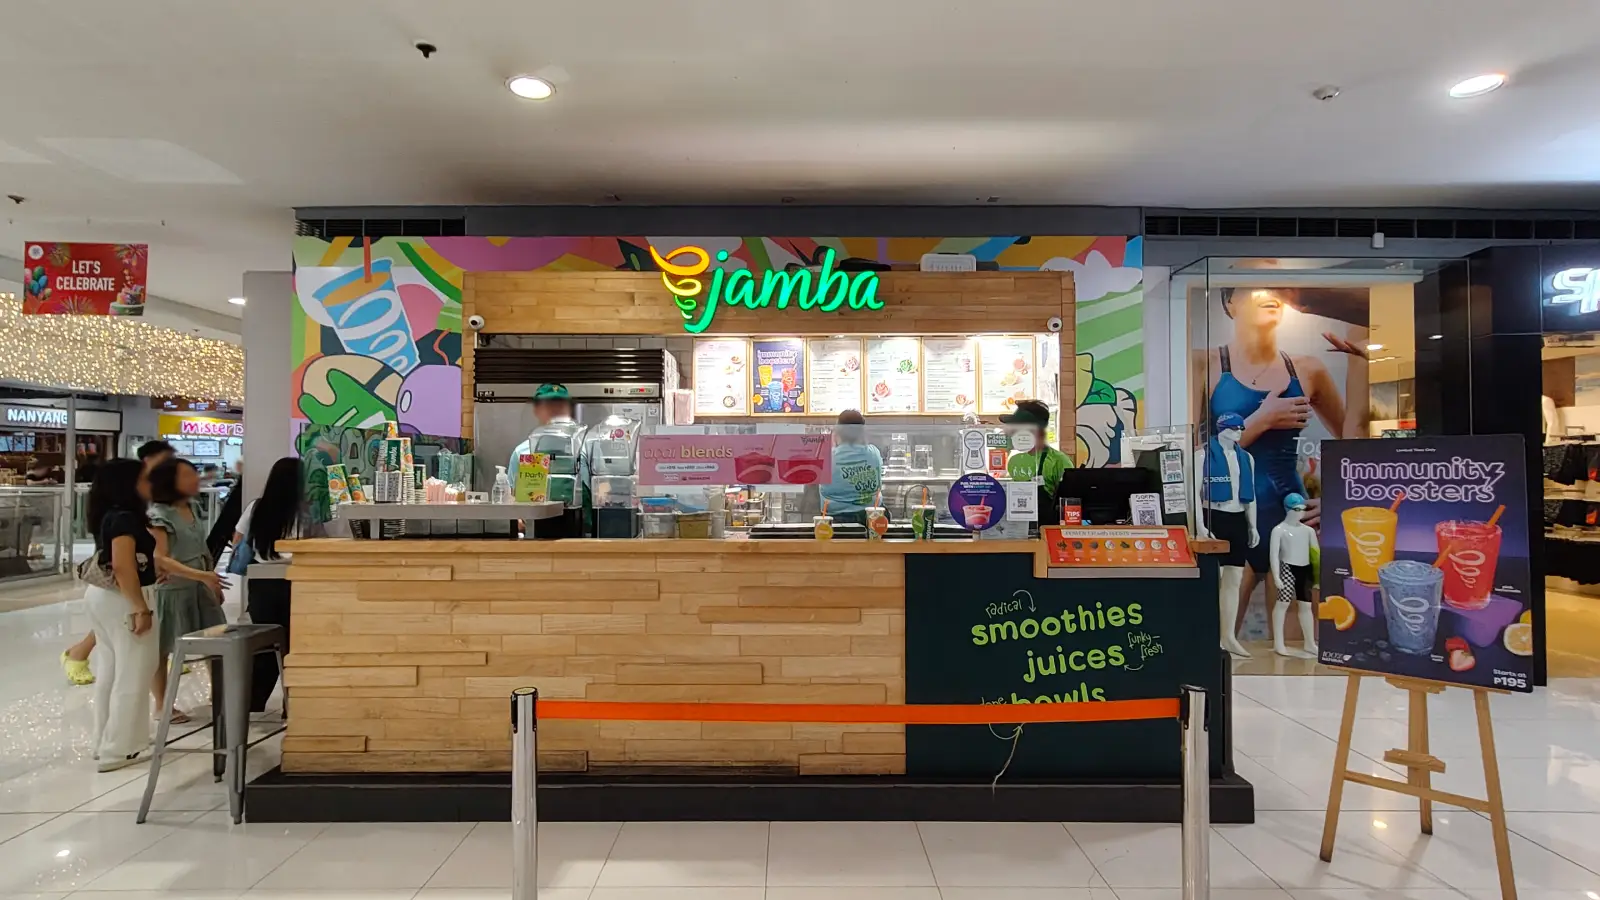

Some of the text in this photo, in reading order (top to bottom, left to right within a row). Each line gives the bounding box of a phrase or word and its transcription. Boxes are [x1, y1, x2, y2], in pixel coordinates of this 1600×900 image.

[72, 259, 101, 275] LET'S
[56, 276, 115, 291] CELEBRATE
[684, 248, 884, 333] jamba
[7, 408, 68, 424] NANYANG
[389, 446, 399, 469] jamba
[680, 444, 733, 459] blends
[1340, 456, 1505, 487] immunity
[1345, 479, 1496, 503] boosters
[985, 599, 1023, 618] radical
[971, 602, 1143, 645] smoothies
[1140, 643, 1164, 661] fresh
[1023, 645, 1126, 683] juices
[1492, 668, 1517, 677] Starts
